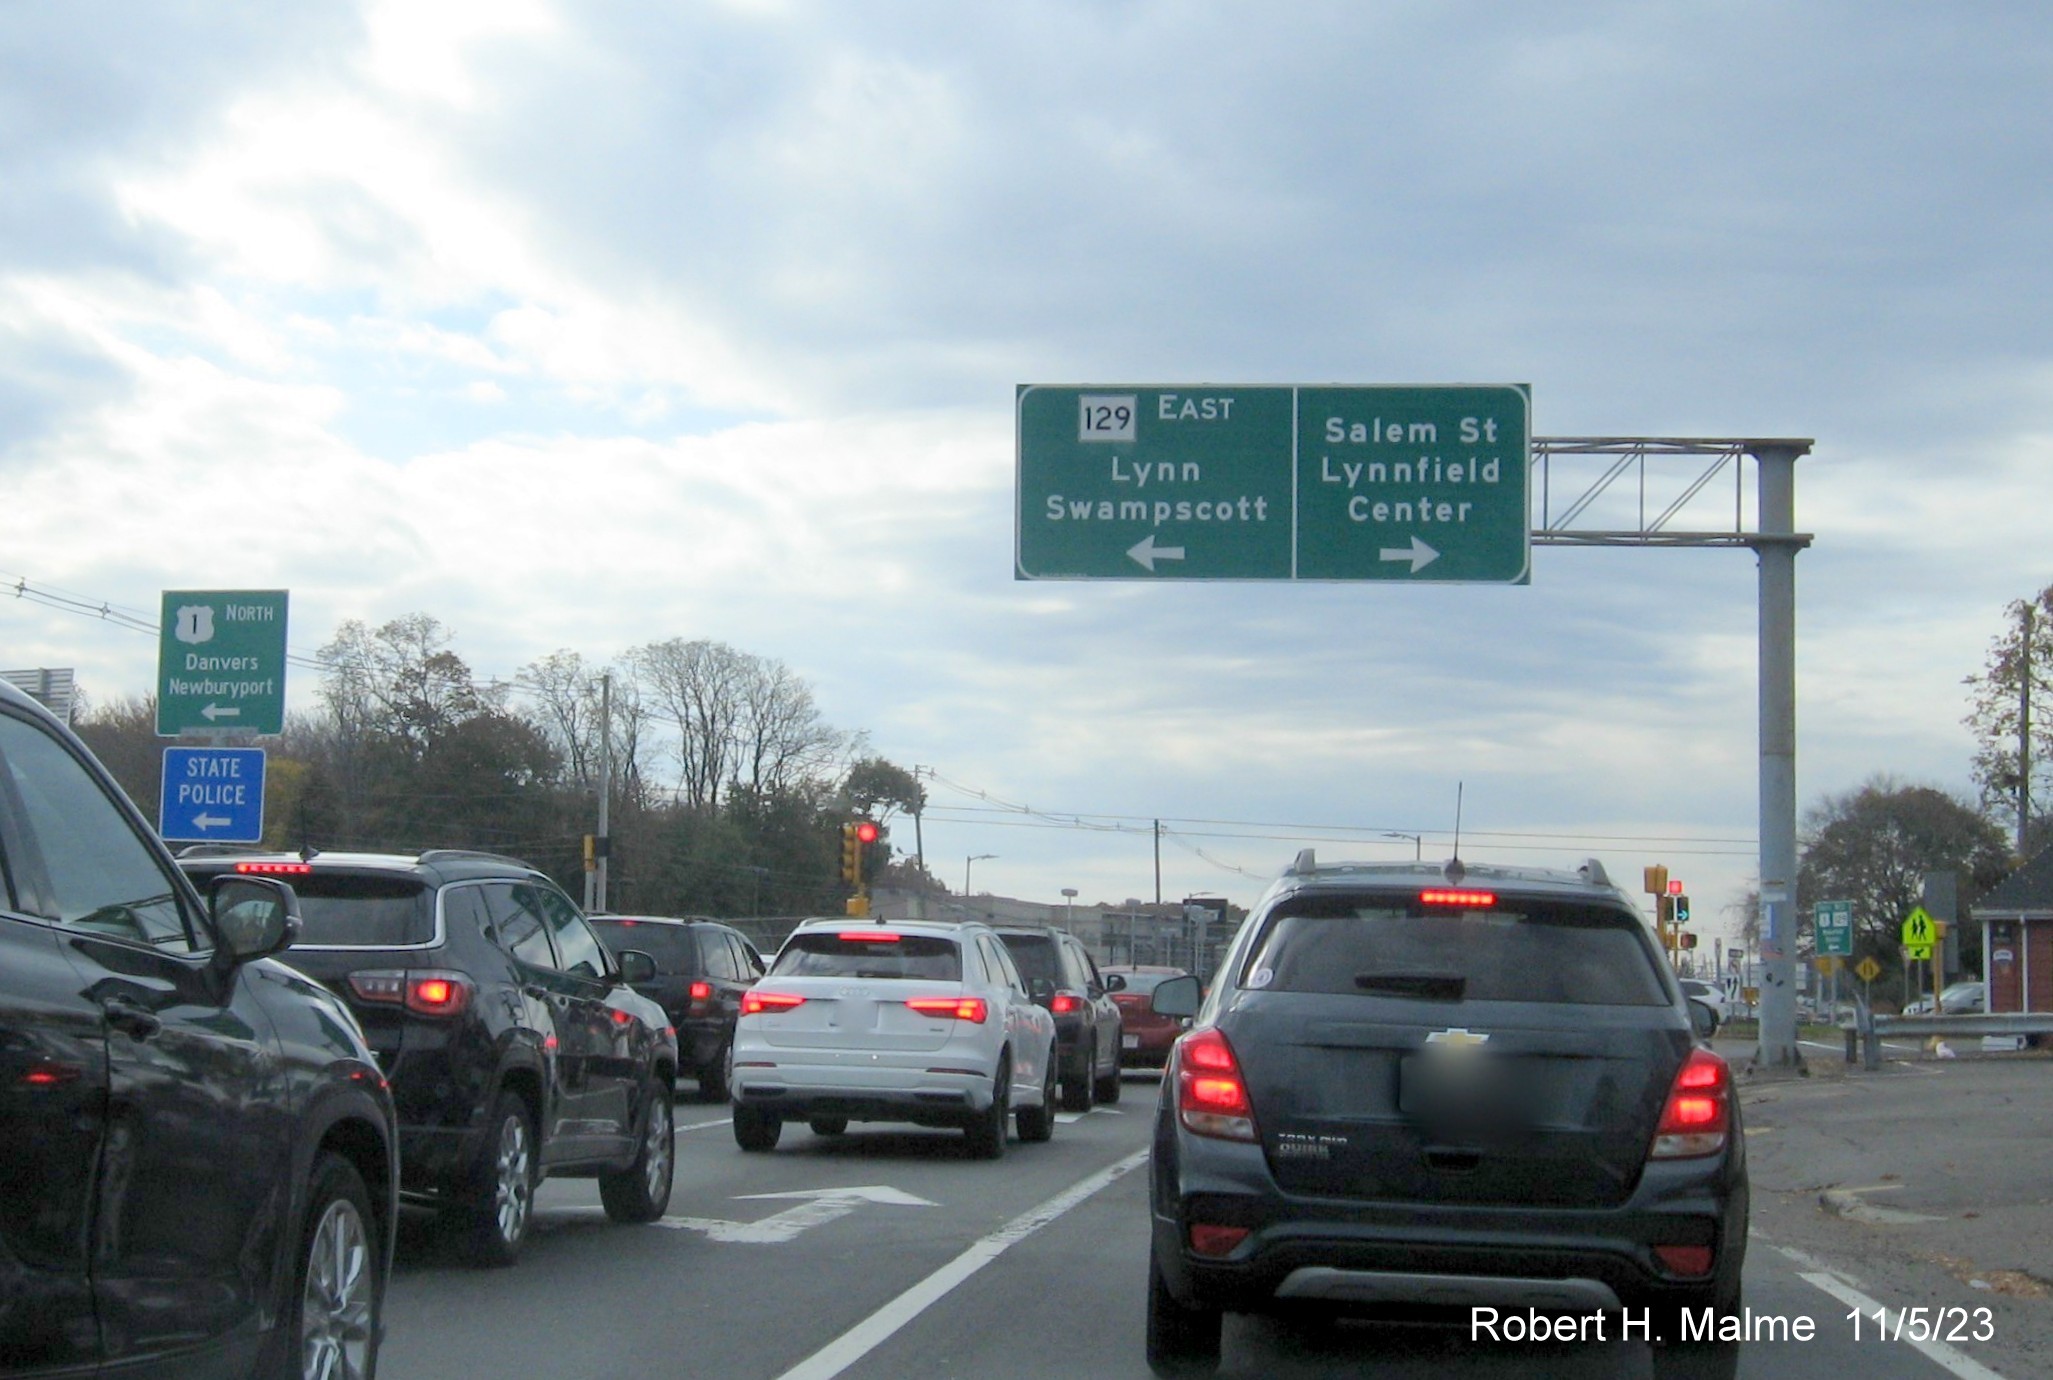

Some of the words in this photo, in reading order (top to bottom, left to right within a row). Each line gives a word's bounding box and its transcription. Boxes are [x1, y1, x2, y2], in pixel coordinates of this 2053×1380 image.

[1085, 406, 1131, 431] 129
[1158, 394, 1235, 420] EAST
[1325, 416, 1437, 443] Salem
[1459, 416, 1498, 443] St
[1111, 456, 1201, 487] Lynn
[1321, 456, 1500, 488] Lynnfield
[1046, 495, 1268, 527] Swampscott
[1348, 496, 1473, 522] Center
[192, 613, 198, 635] 1
[226, 604, 274, 621] NORTH
[185, 653, 259, 671] Danvers
[169, 678, 273, 699] Newburyport
[187, 757, 241, 778] STATE
[179, 784, 246, 805] POLICE
